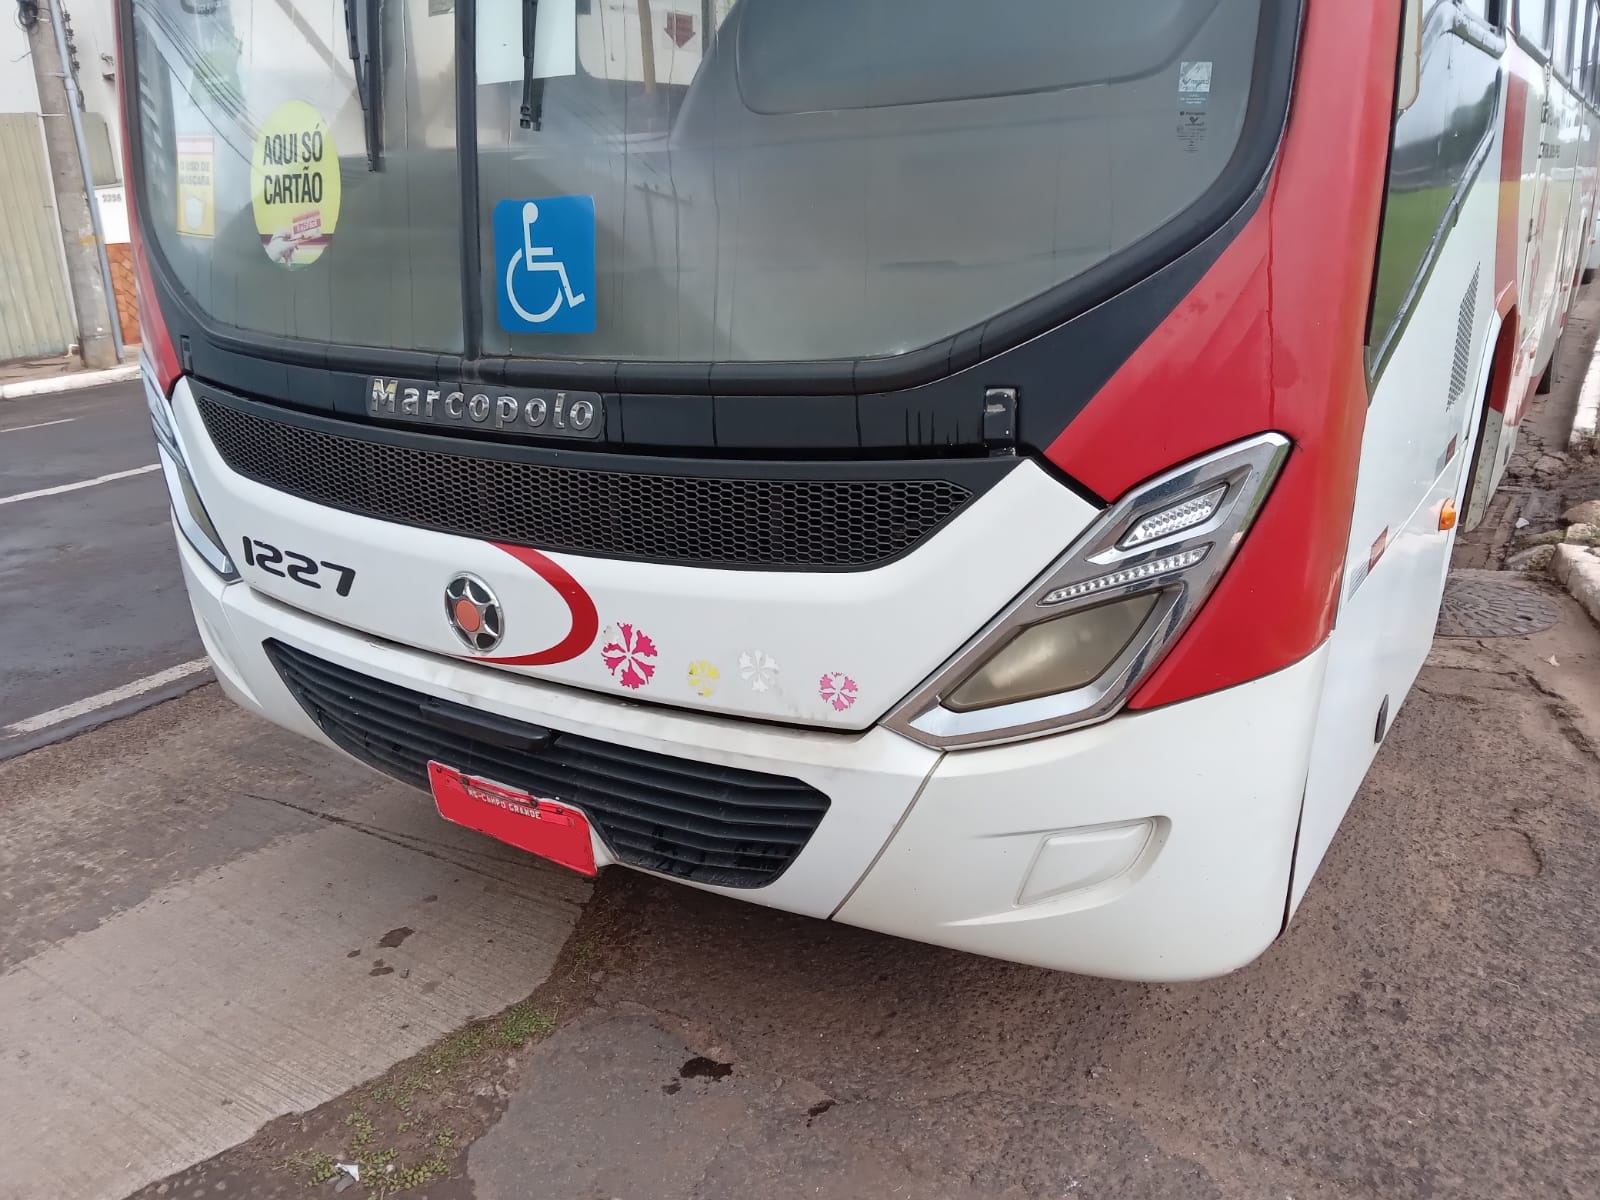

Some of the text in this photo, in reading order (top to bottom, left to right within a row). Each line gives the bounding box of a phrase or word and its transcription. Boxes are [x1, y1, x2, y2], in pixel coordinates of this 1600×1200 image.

[264, 123, 323, 165] AQUI SÓ
[264, 166, 323, 205] CARTÃO
[371, 378, 594, 430] Marcopolo
[242, 535, 356, 597] 1227
